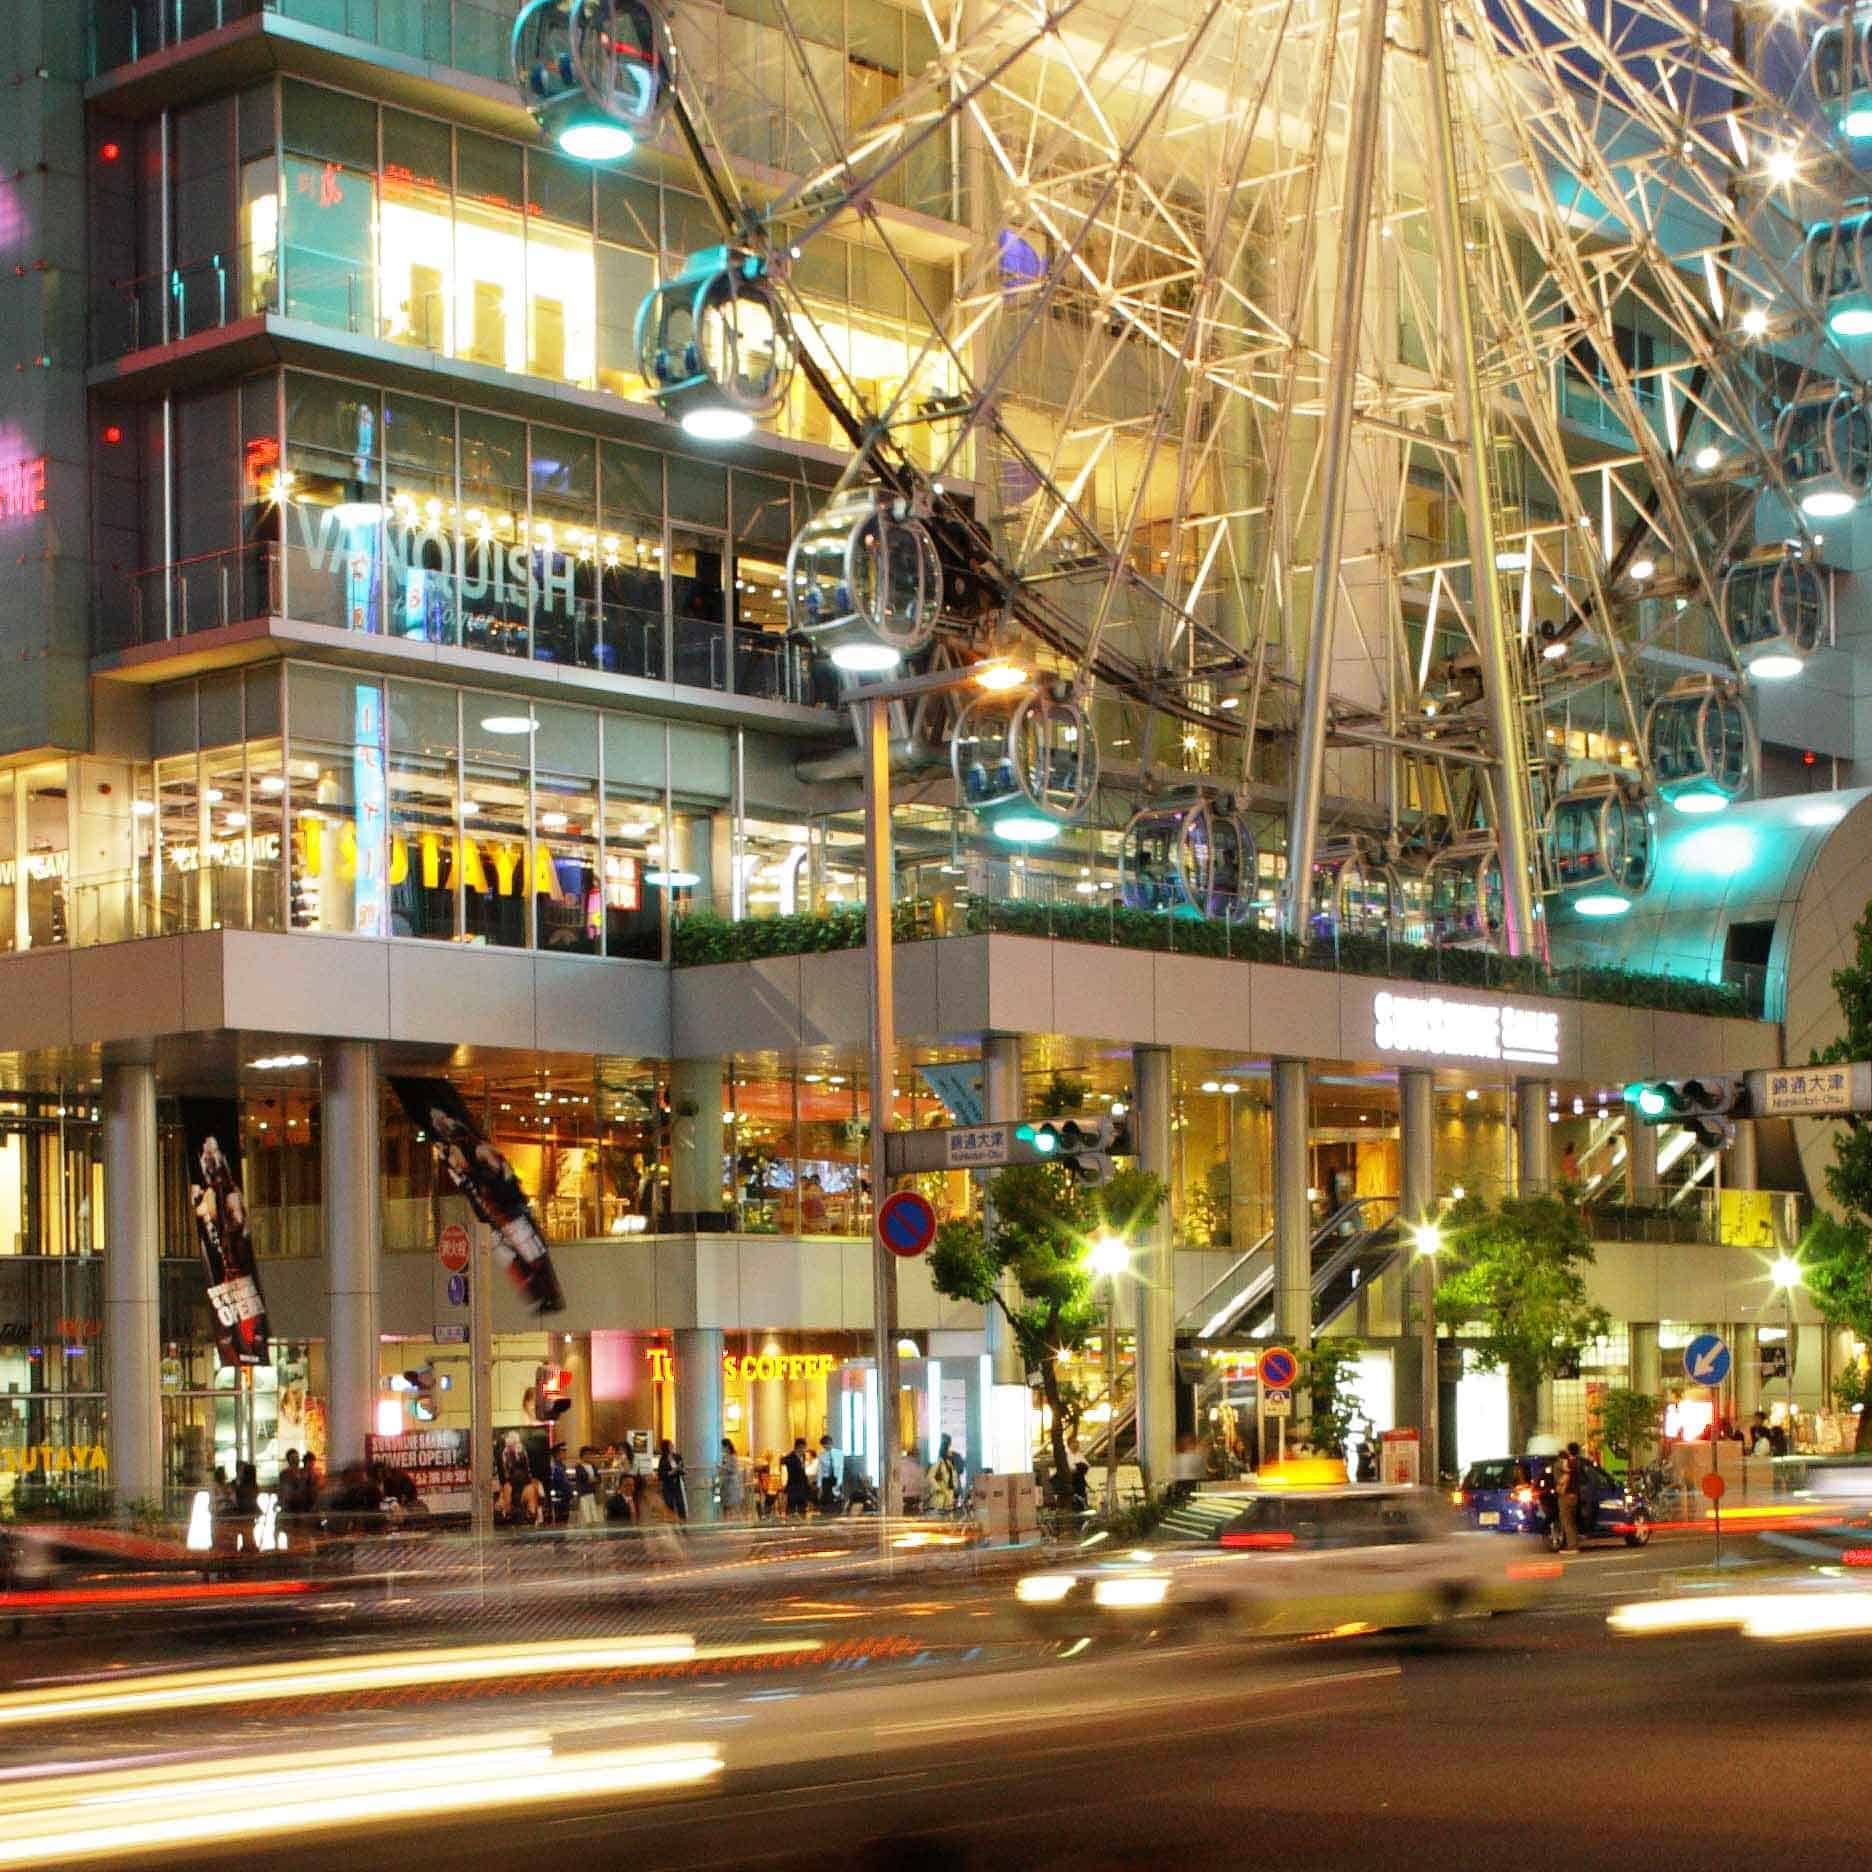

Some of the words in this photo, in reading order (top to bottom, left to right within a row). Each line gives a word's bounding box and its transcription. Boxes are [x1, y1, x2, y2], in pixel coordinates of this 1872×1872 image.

[297, 503, 576, 618] VANQUISH
[296, 813, 566, 902] TSUTAYA
[740, 1353, 834, 1383] COFFEE
